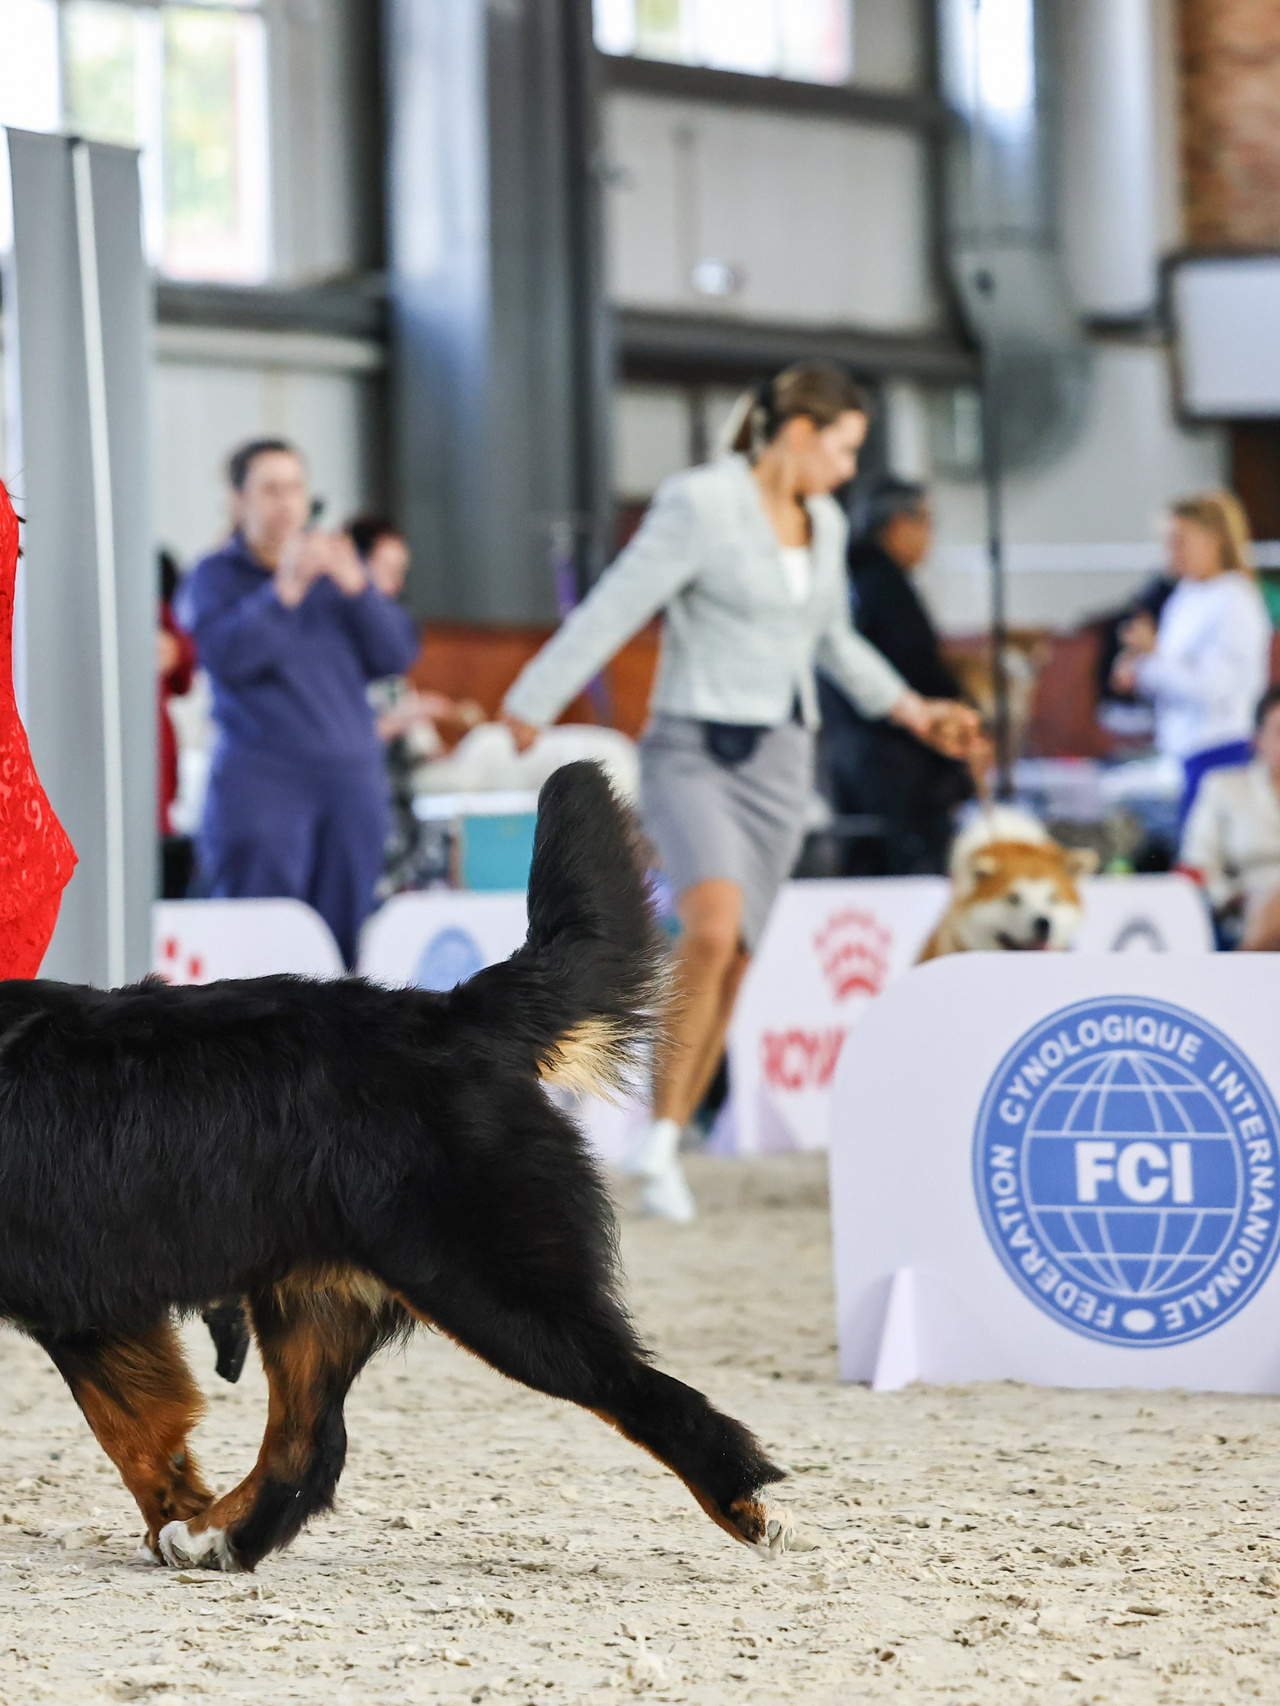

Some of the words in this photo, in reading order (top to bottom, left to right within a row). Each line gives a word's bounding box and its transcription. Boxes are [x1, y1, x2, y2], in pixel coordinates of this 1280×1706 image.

[999, 1014, 1203, 1125] CYNOLOGIQUE
[989, 1144, 1117, 1329] FEDERATION
[1075, 1141, 1194, 1204] FCI
[1160, 1060, 1276, 1330] INTERNANIONALE
